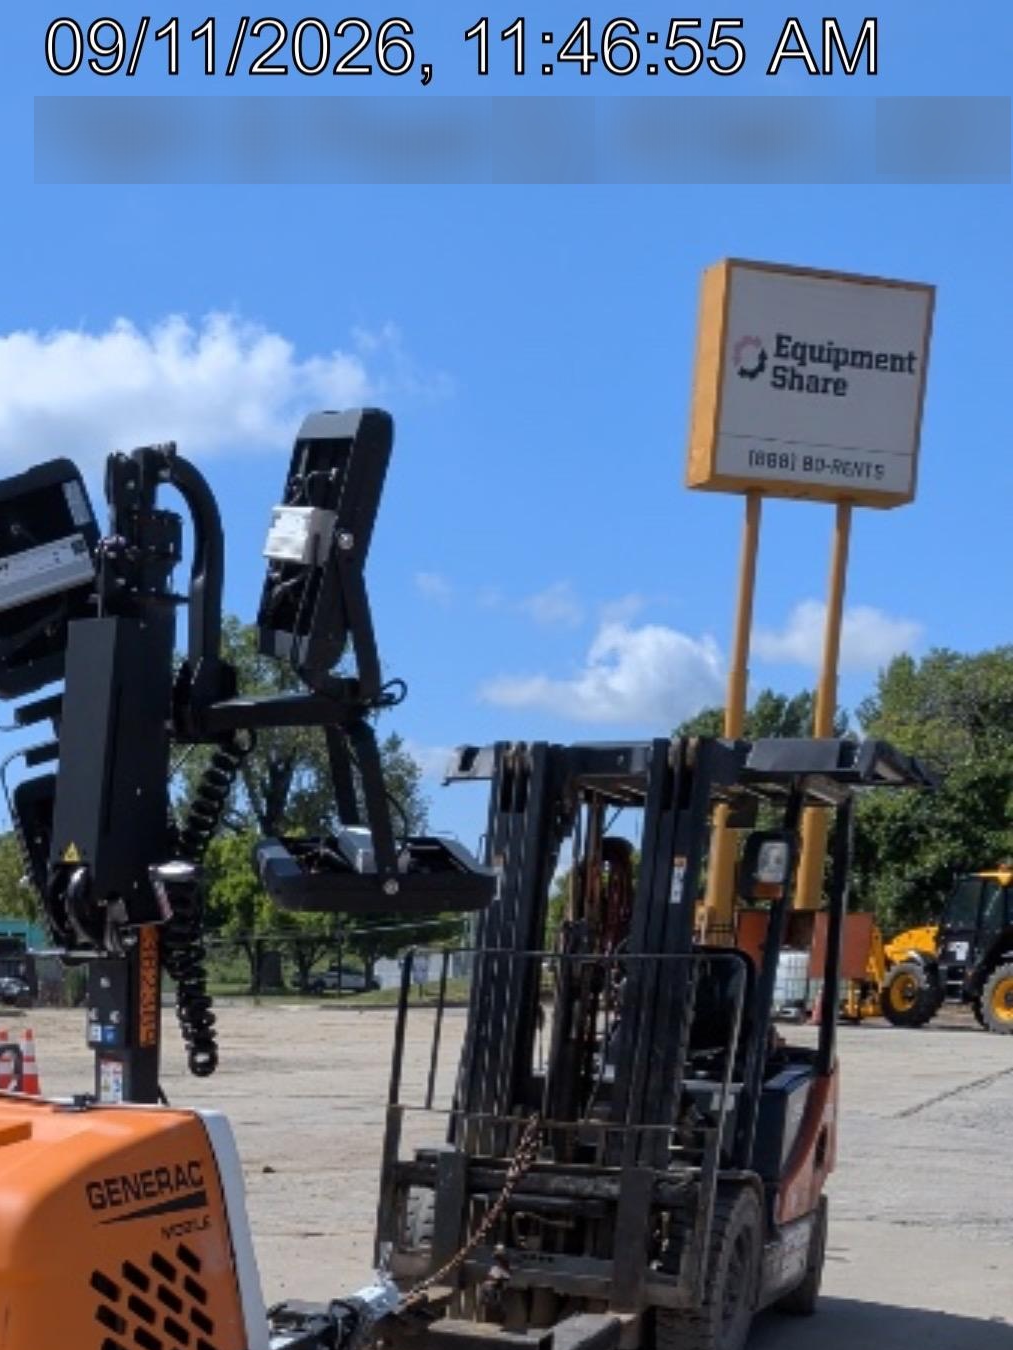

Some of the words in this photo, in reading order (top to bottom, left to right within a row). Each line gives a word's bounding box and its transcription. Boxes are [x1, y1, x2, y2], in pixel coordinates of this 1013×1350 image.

[774, 332, 917, 374] Equipment
[770, 365, 849, 397] Share
[86, 1159, 205, 1210] GENERAC
